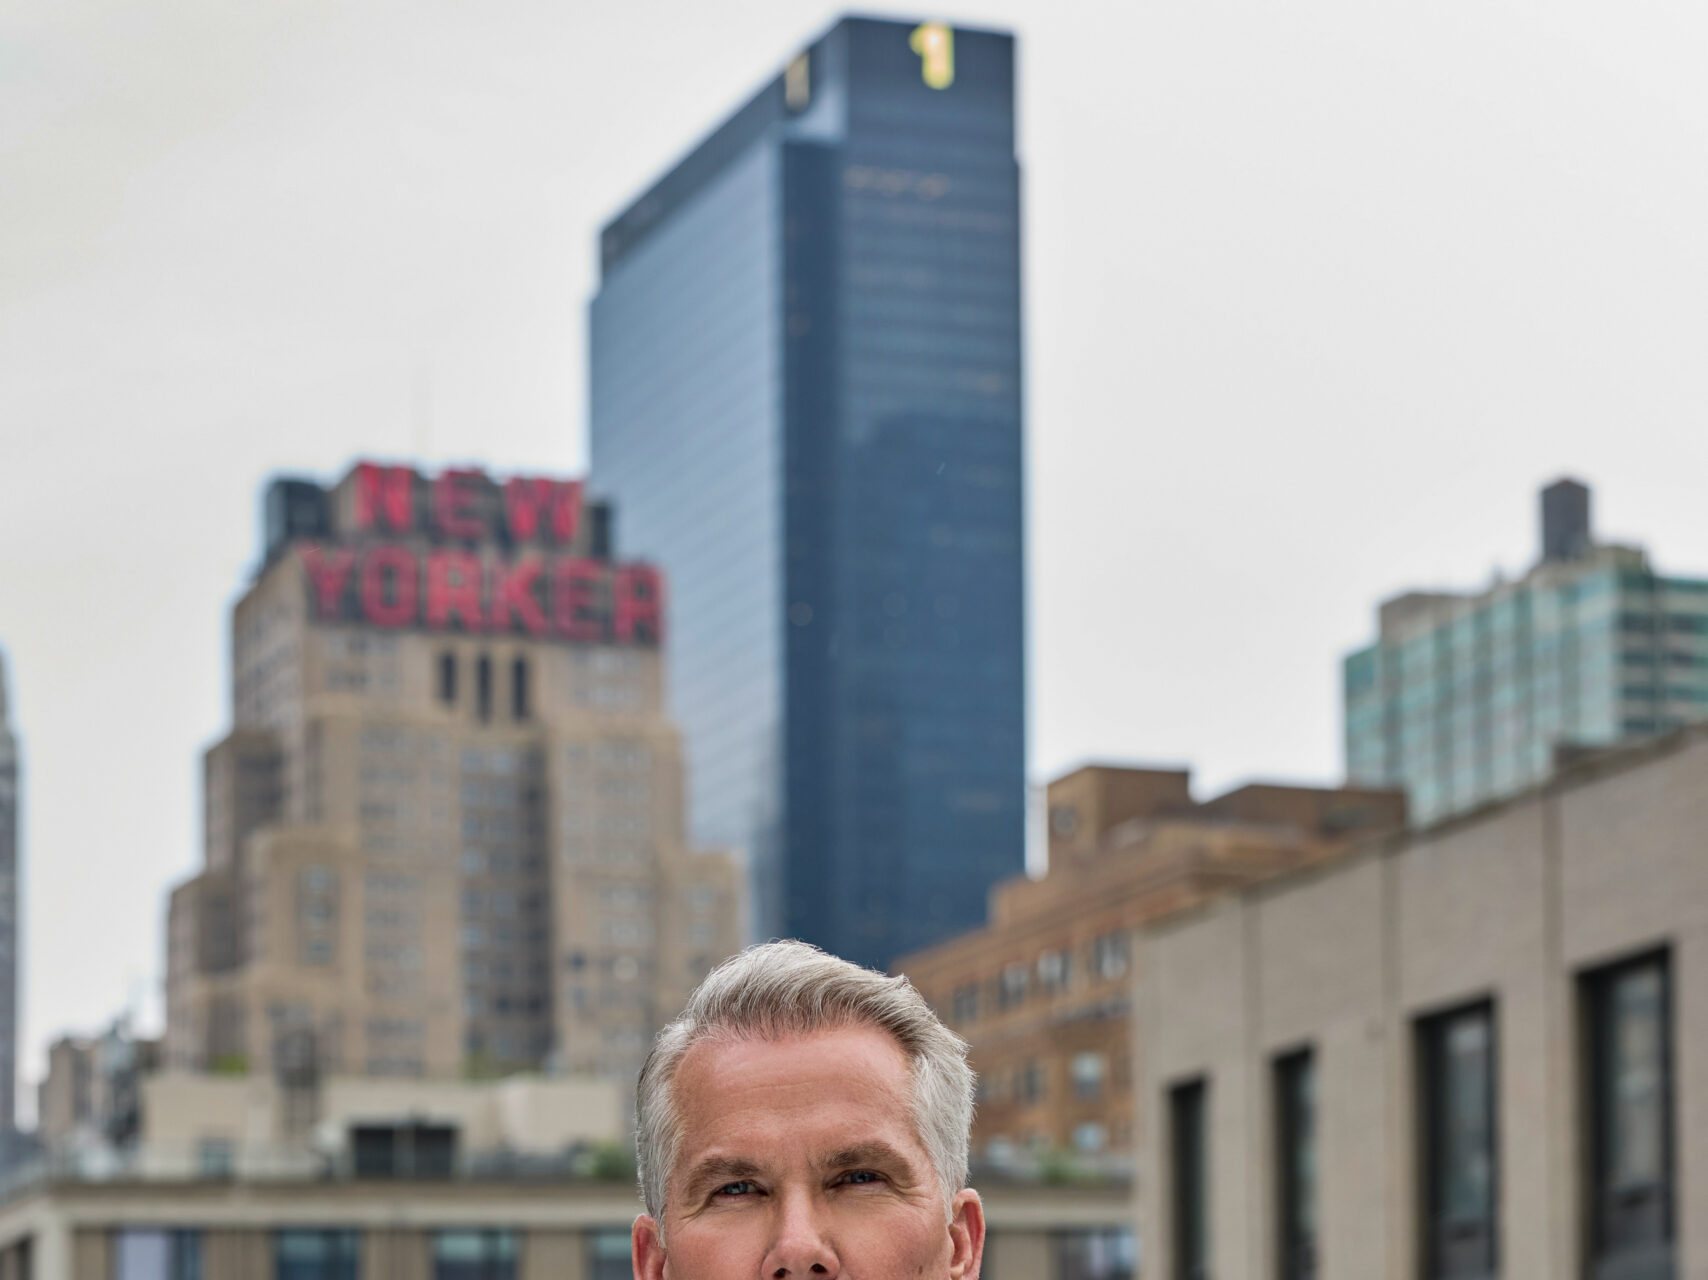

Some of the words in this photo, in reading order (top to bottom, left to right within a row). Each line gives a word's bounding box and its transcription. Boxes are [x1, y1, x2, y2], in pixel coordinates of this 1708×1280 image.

[909, 22, 954, 90] 1
[354, 462, 586, 541] NEW
[303, 545, 664, 644] YORKER
